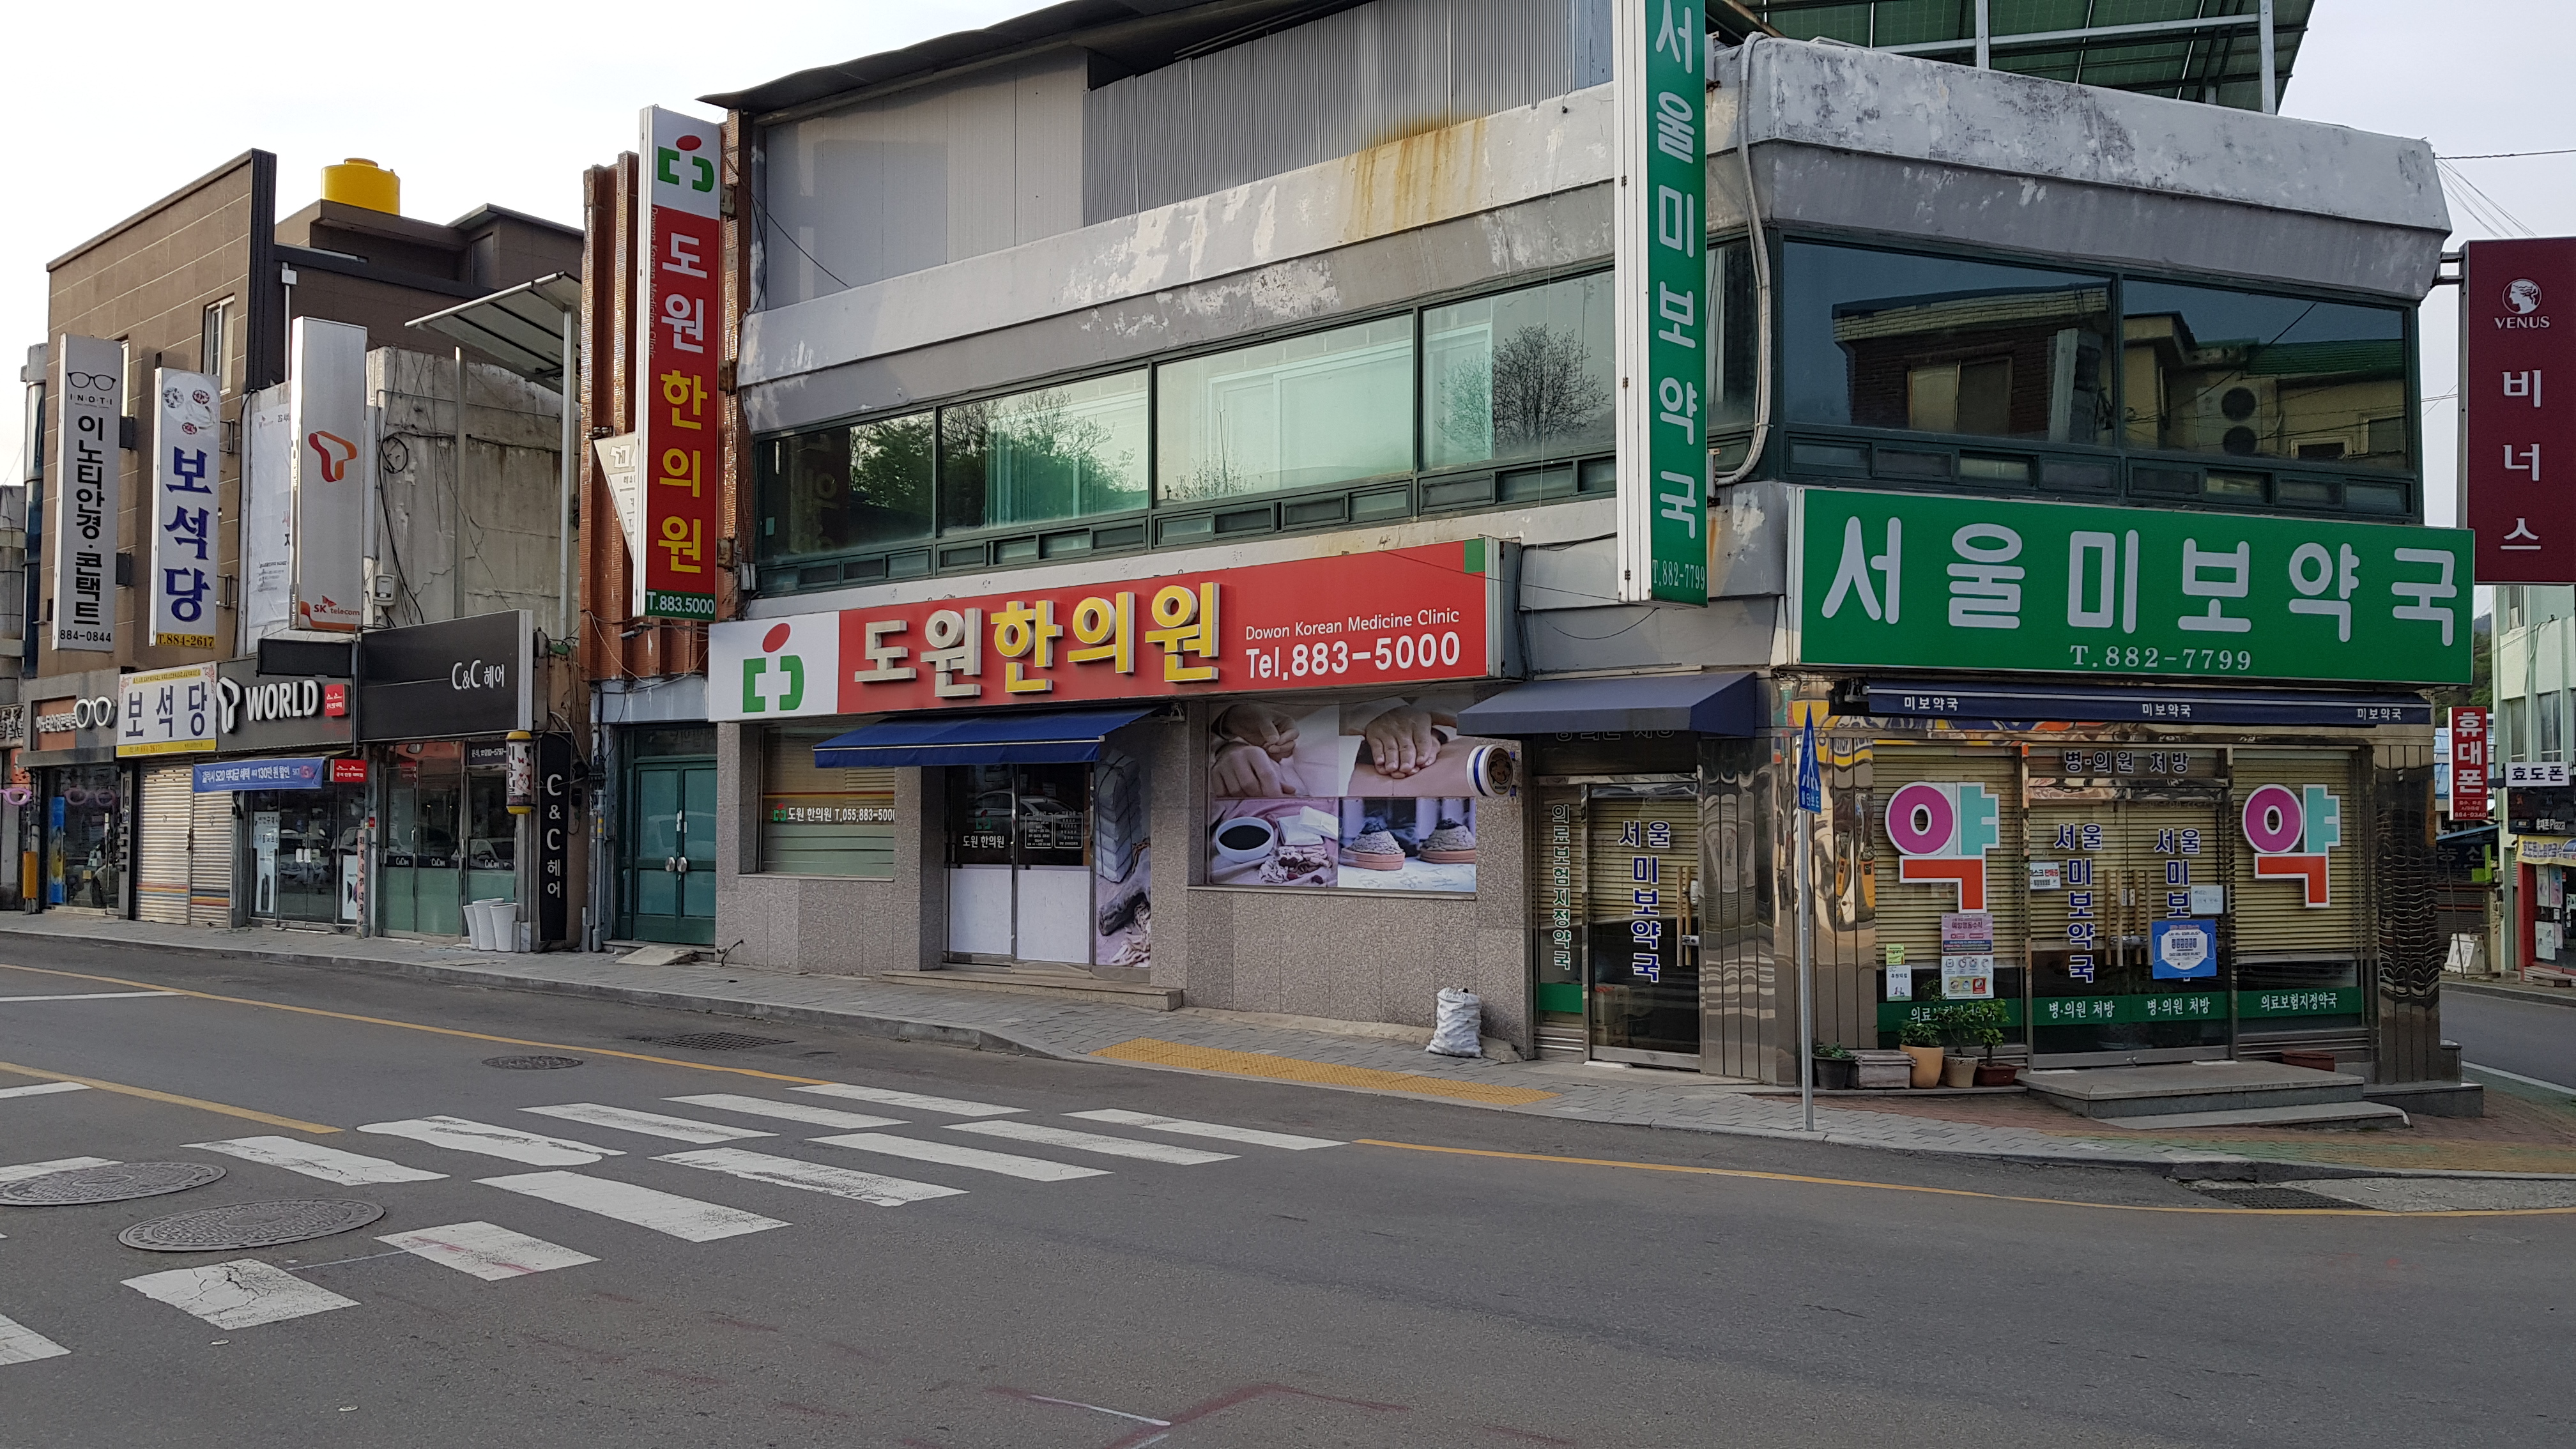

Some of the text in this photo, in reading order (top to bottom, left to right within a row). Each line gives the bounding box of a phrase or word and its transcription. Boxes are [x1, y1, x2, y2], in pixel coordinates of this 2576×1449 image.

[1655, 5, 1697, 540] 서울미보약국
[2494, 316, 2550, 329] VENUS
[70, 393, 112, 405] INOTI
[658, 232, 708, 574] 도원한의원
[2500, 369, 2542, 550] 비너스
[164, 446, 213, 622] 보석당
[1652, 559, 1706, 591] T.882-7799
[1821, 516, 2458, 648] 서울미보약국
[313, 604, 360, 617] SK telecom
[647, 590, 715, 615] T.883.5000
[59, 629, 112, 643] 884-0844
[1245, 608, 1460, 640] Dowon Korean Medicine Clinic
[157, 633, 215, 648] T.884-2617
[855, 581, 1220, 700] 도원한의원
[1245, 631, 1460, 680] Tel.883-5000
[2069, 644, 2253, 671] T.882-7799
[452, 659, 505, 690] C&C 헤어
[125, 680, 208, 739] 보석당
[245, 679, 319, 721] WORLD
[1903, 696, 1959, 712] 미보약국
[2142, 703, 2192, 718] 미보약국
[2356, 707, 2402, 721] 미보약국
[2149, 750, 2190, 775] 처방
[2455, 712, 2484, 793] 휴대폰
[2511, 765, 2564, 781] 효도폰
[788, 807, 804, 822] 도원
[807, 807, 832, 822] 한의원
[962, 834, 1005, 848] 도원 한의원
[1618, 820, 1672, 849] 서울
[1885, 781, 2000, 914] 약
[2054, 822, 2104, 851] 서울
[2154, 828, 2201, 855] 서울
[2242, 783, 2342, 908] 약
[1551, 804, 1572, 970] 의료보험지정약국
[1631, 855, 1662, 983] 미보약국
[2066, 857, 2096, 984] 미보약국
[2048, 1000, 2116, 1020] 병·의원 처방
[2147, 996, 2211, 1016] 병·의원 처방
[2260, 992, 2338, 1011] 의료보험지정약국
